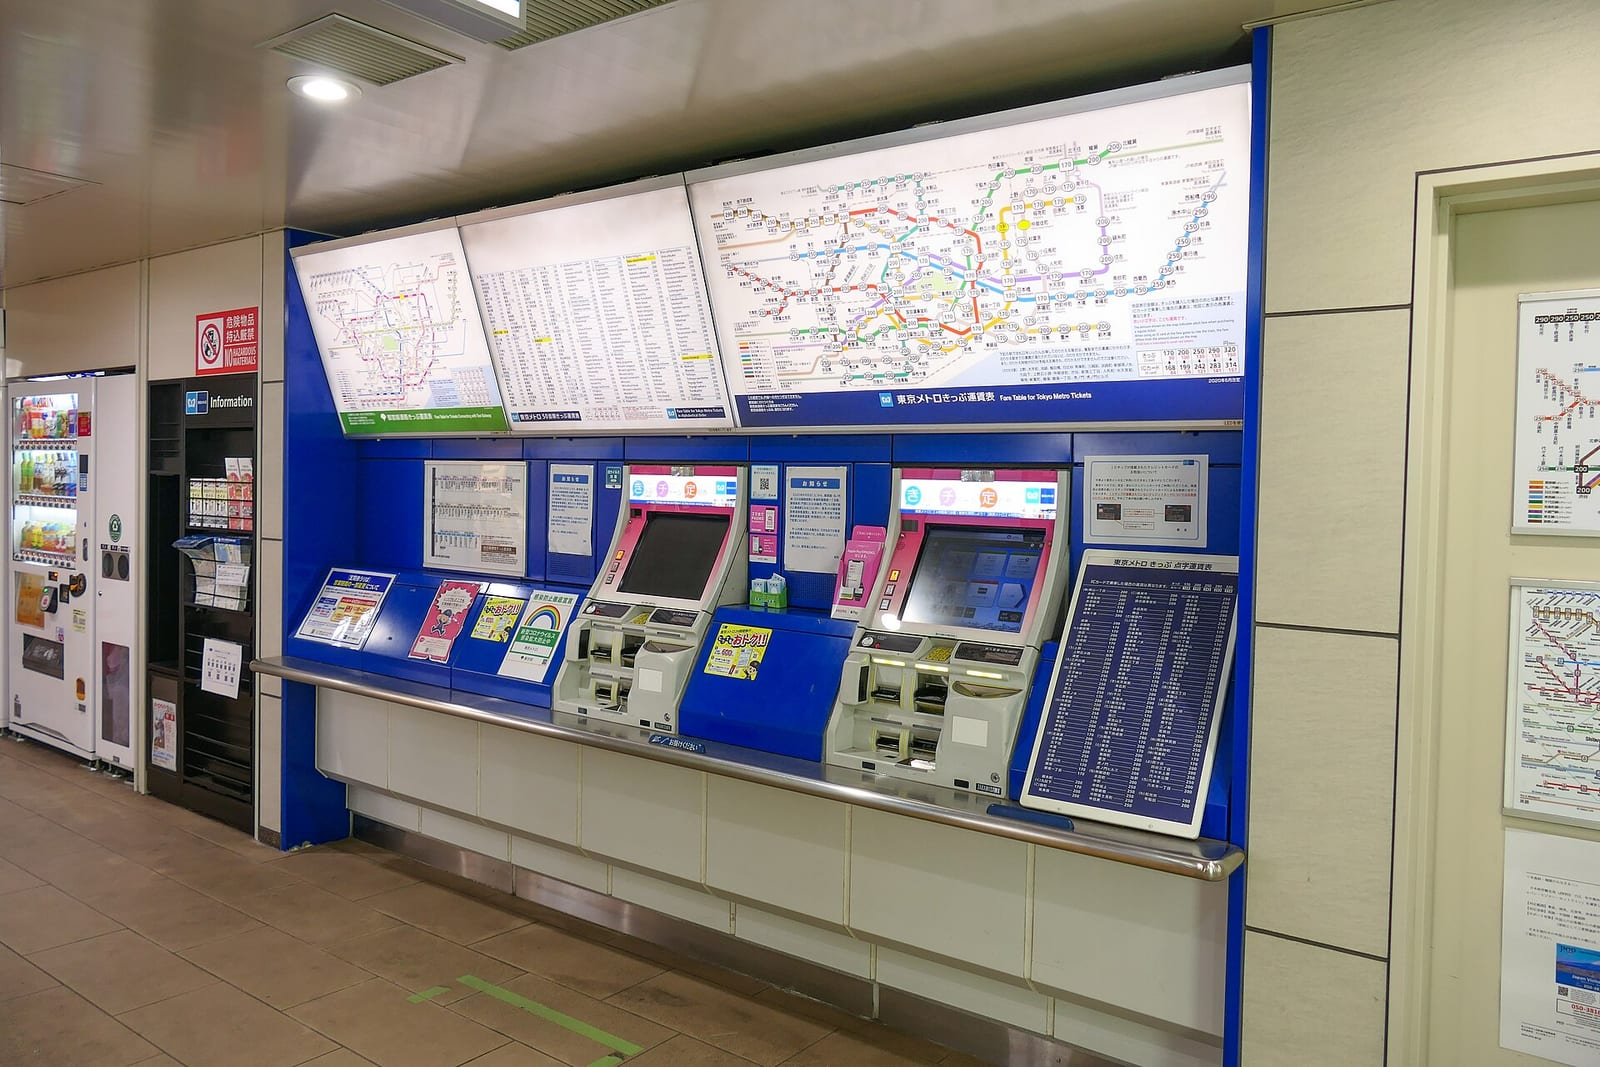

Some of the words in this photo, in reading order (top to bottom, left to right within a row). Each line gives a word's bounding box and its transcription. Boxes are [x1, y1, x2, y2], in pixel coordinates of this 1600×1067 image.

[225, 349, 232, 367] NO
[210, 395, 252, 408] Information
[896, 392, 995, 404] 東京メトロきっぷ運賃表
[686, 484, 696, 494] 定
[983, 493, 995, 504] 定
[1150, 560, 1172, 568] きっぷ
